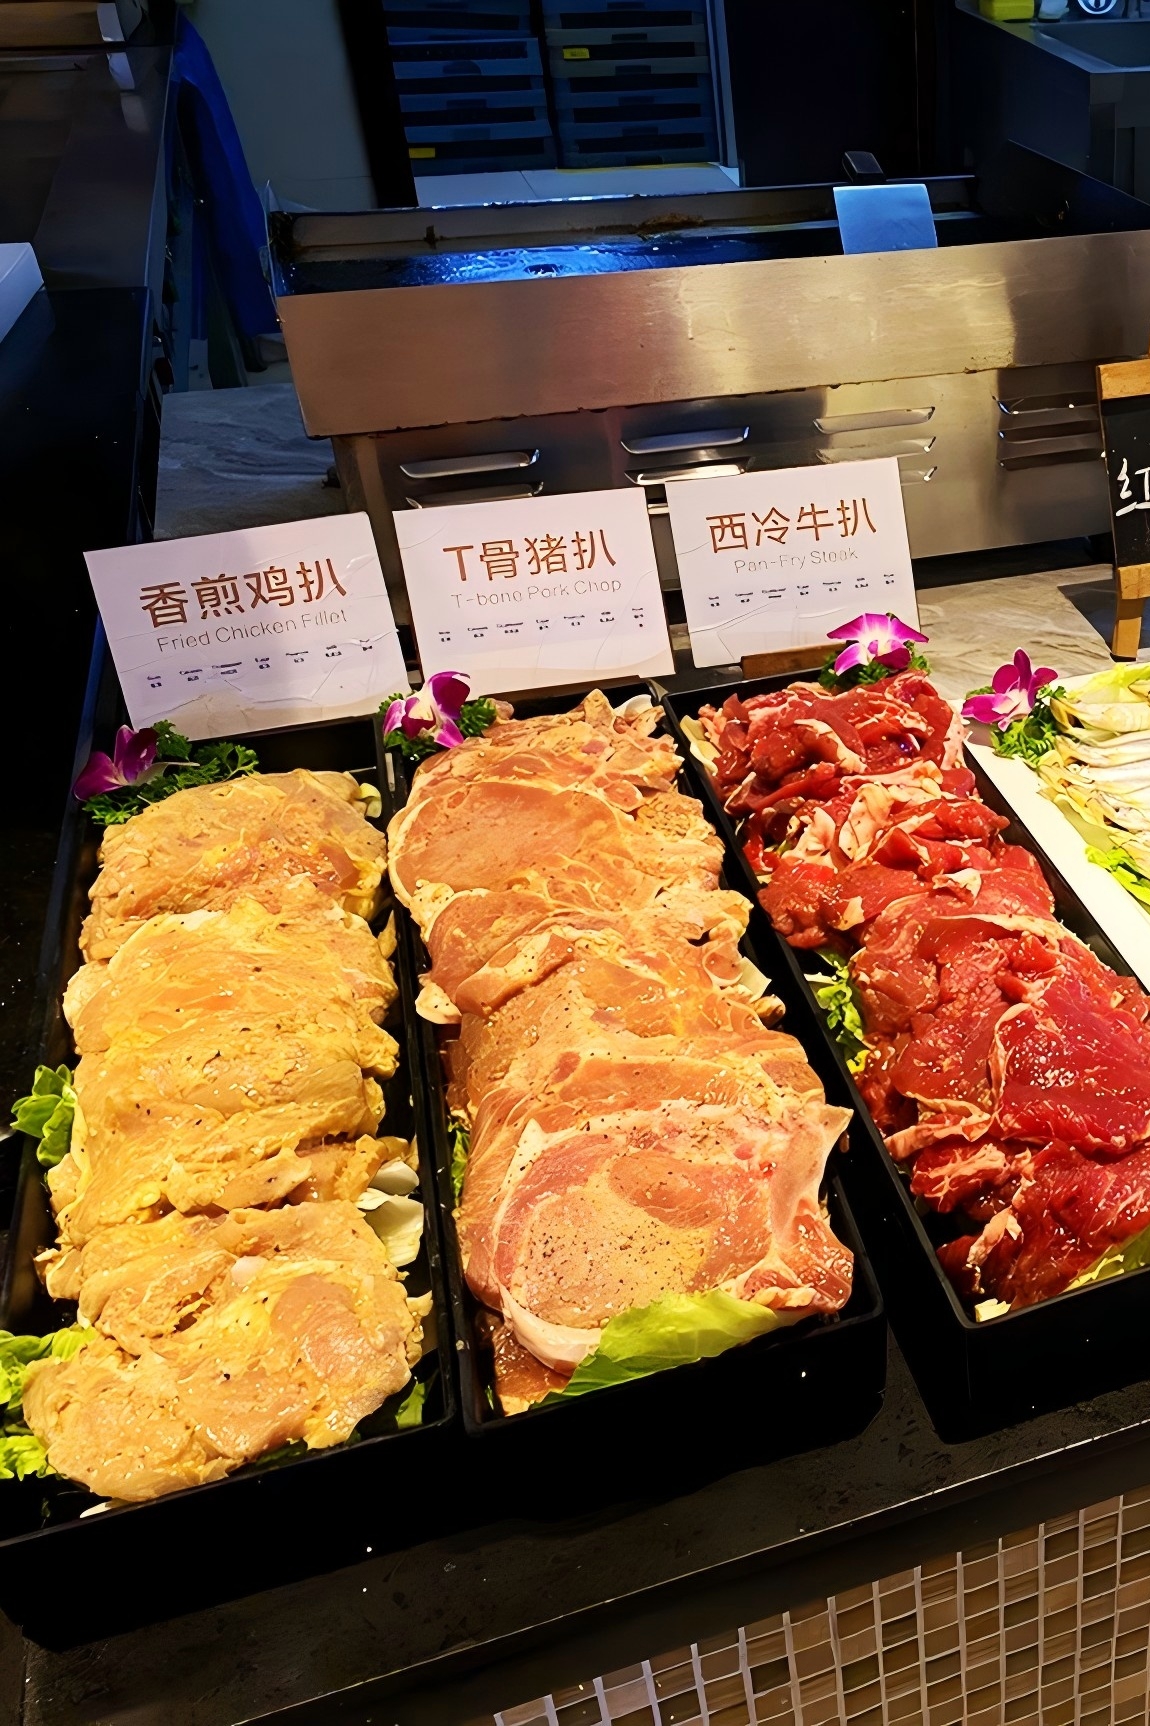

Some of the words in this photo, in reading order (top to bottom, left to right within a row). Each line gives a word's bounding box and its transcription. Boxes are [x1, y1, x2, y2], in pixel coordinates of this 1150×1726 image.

[706, 497, 877, 554] 西冷牛扒
[442, 528, 617, 582] T骨猪扒
[734, 554, 806, 574] Pan-Fry
[139, 558, 347, 629] 香煎鸡扒
[451, 588, 523, 609] T-bone
[527, 582, 570, 601] Pork
[573, 579, 622, 595] Chop
[157, 630, 210, 653] Fried
[215, 615, 297, 643] Chicken
[301, 609, 348, 630] Fillet
